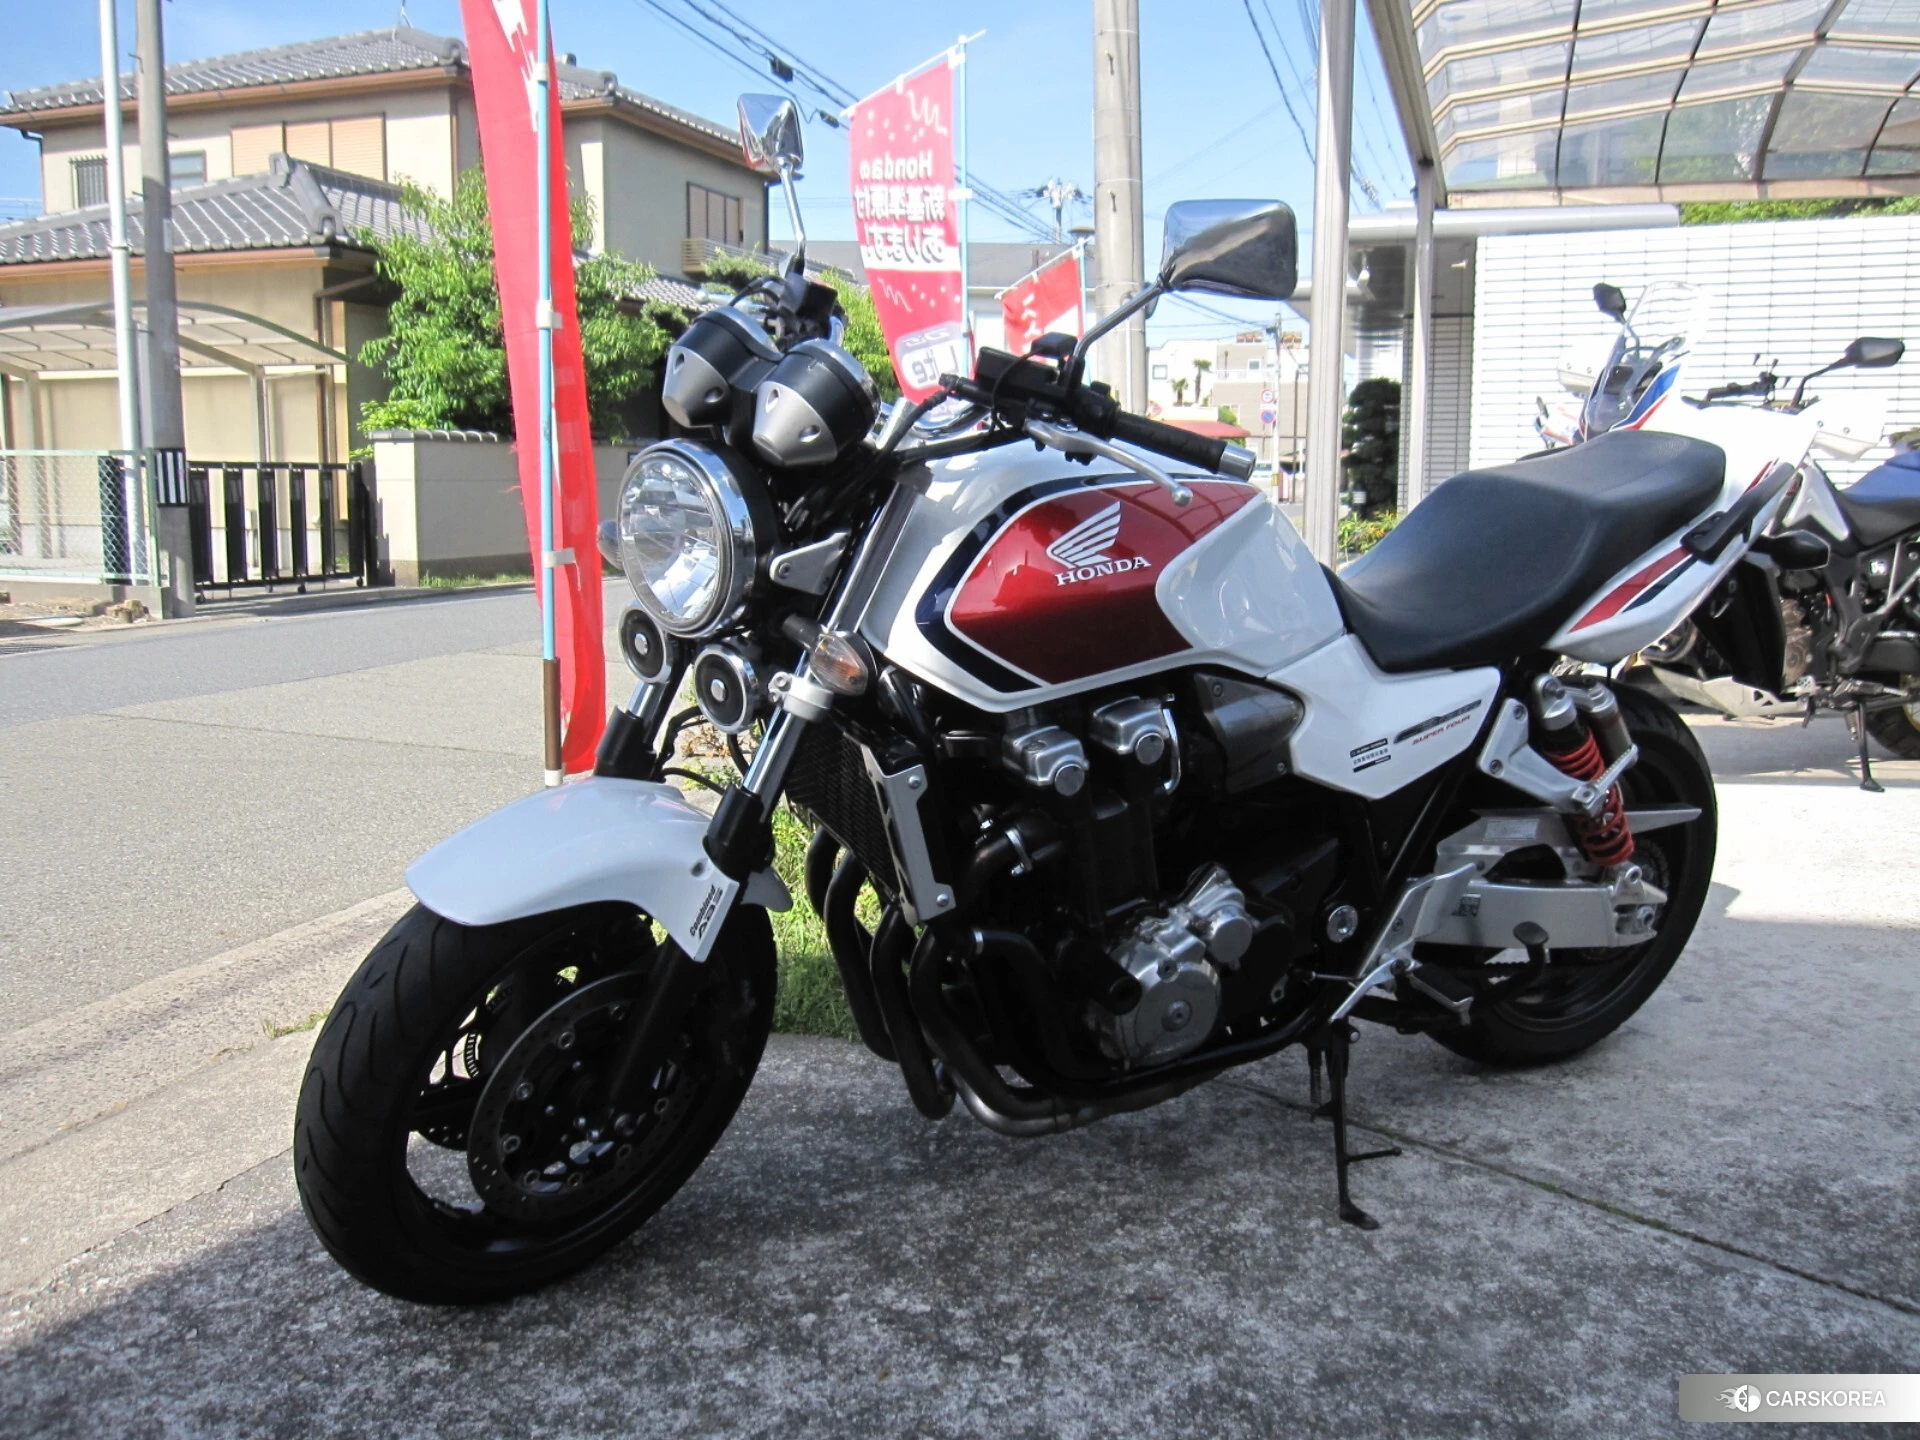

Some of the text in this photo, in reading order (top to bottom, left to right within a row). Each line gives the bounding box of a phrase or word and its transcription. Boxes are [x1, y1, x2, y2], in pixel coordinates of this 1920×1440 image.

[1055, 556, 1151, 587] HONDA
[1412, 714, 1471, 745] SUPER FOUR
[689, 884, 716, 937] Combined
